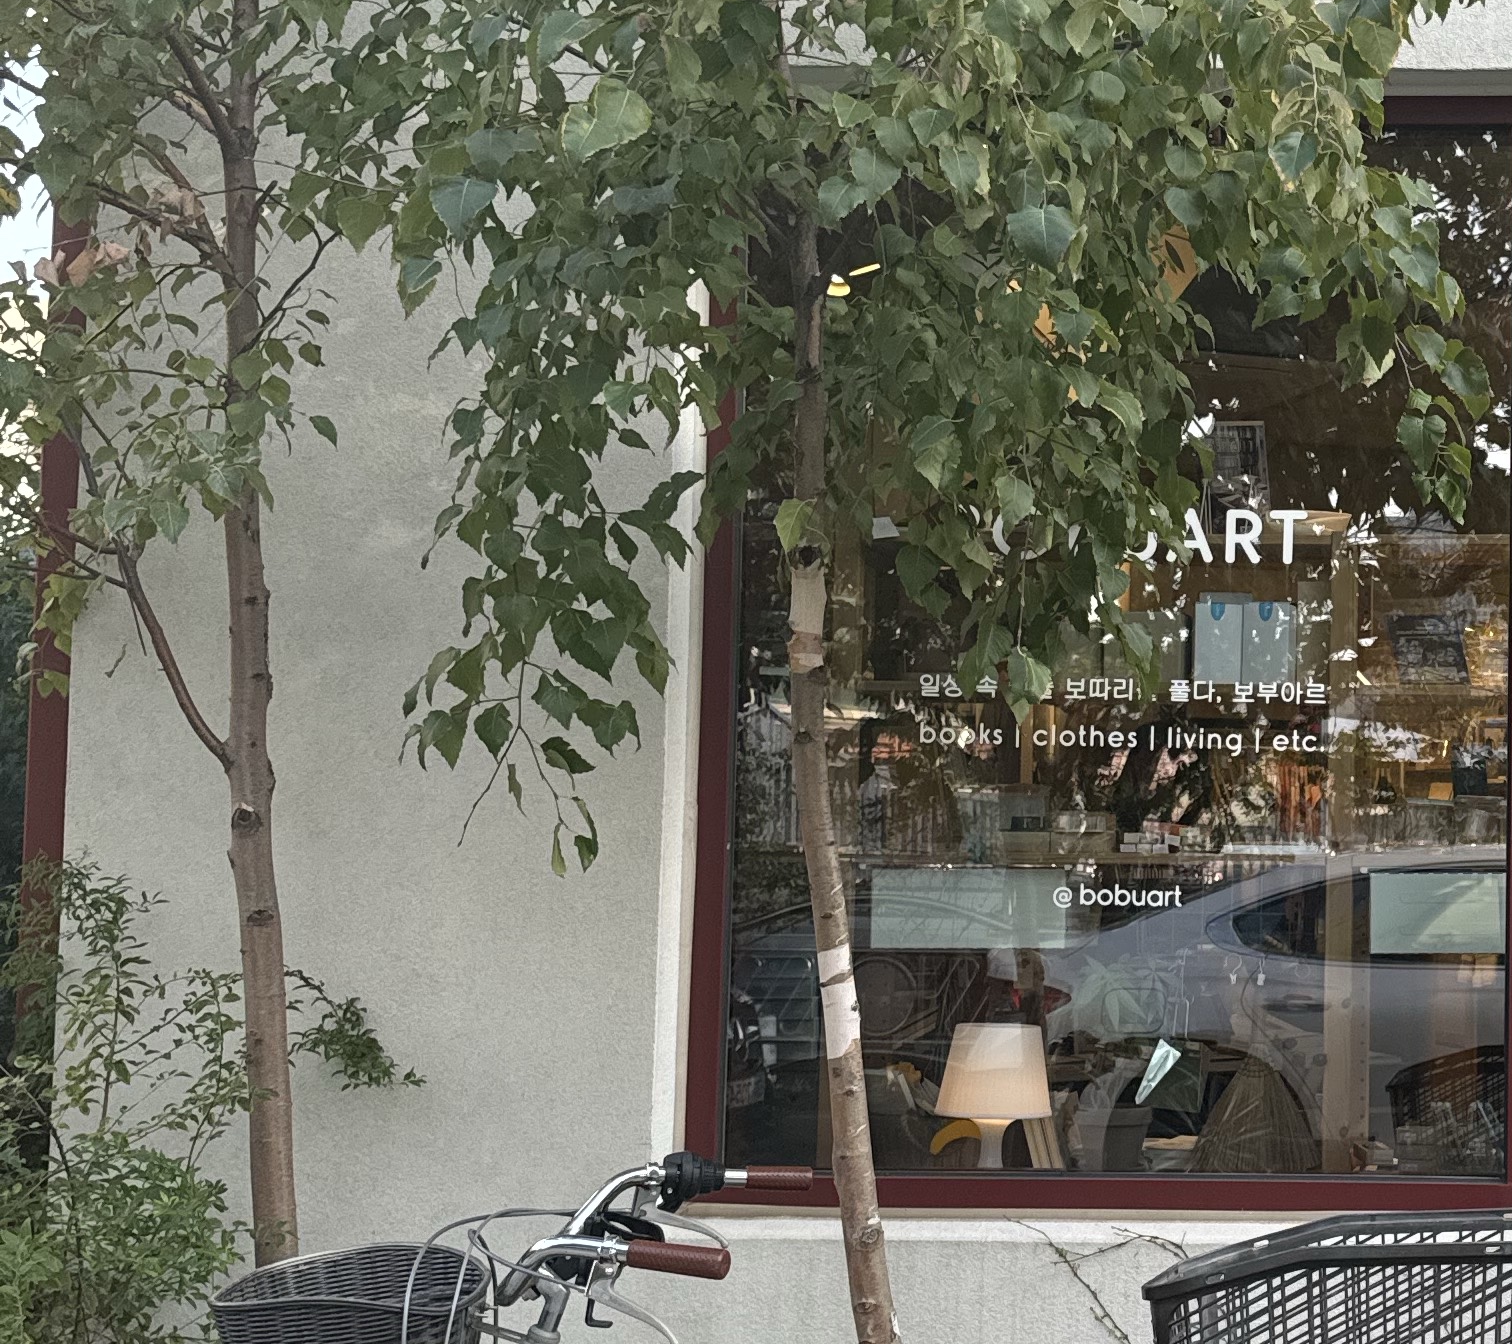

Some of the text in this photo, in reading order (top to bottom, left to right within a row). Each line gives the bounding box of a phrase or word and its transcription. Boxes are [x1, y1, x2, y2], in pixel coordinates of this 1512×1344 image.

[976, 674, 998, 699] 속
[1168, 679, 1222, 704] 풀다,
[1231, 680, 1327, 705] 보부아르
[919, 721, 1003, 745] books
[1032, 724, 1138, 748] clothes
[1167, 726, 1242, 757] living
[1272, 729, 1326, 753] etc.
